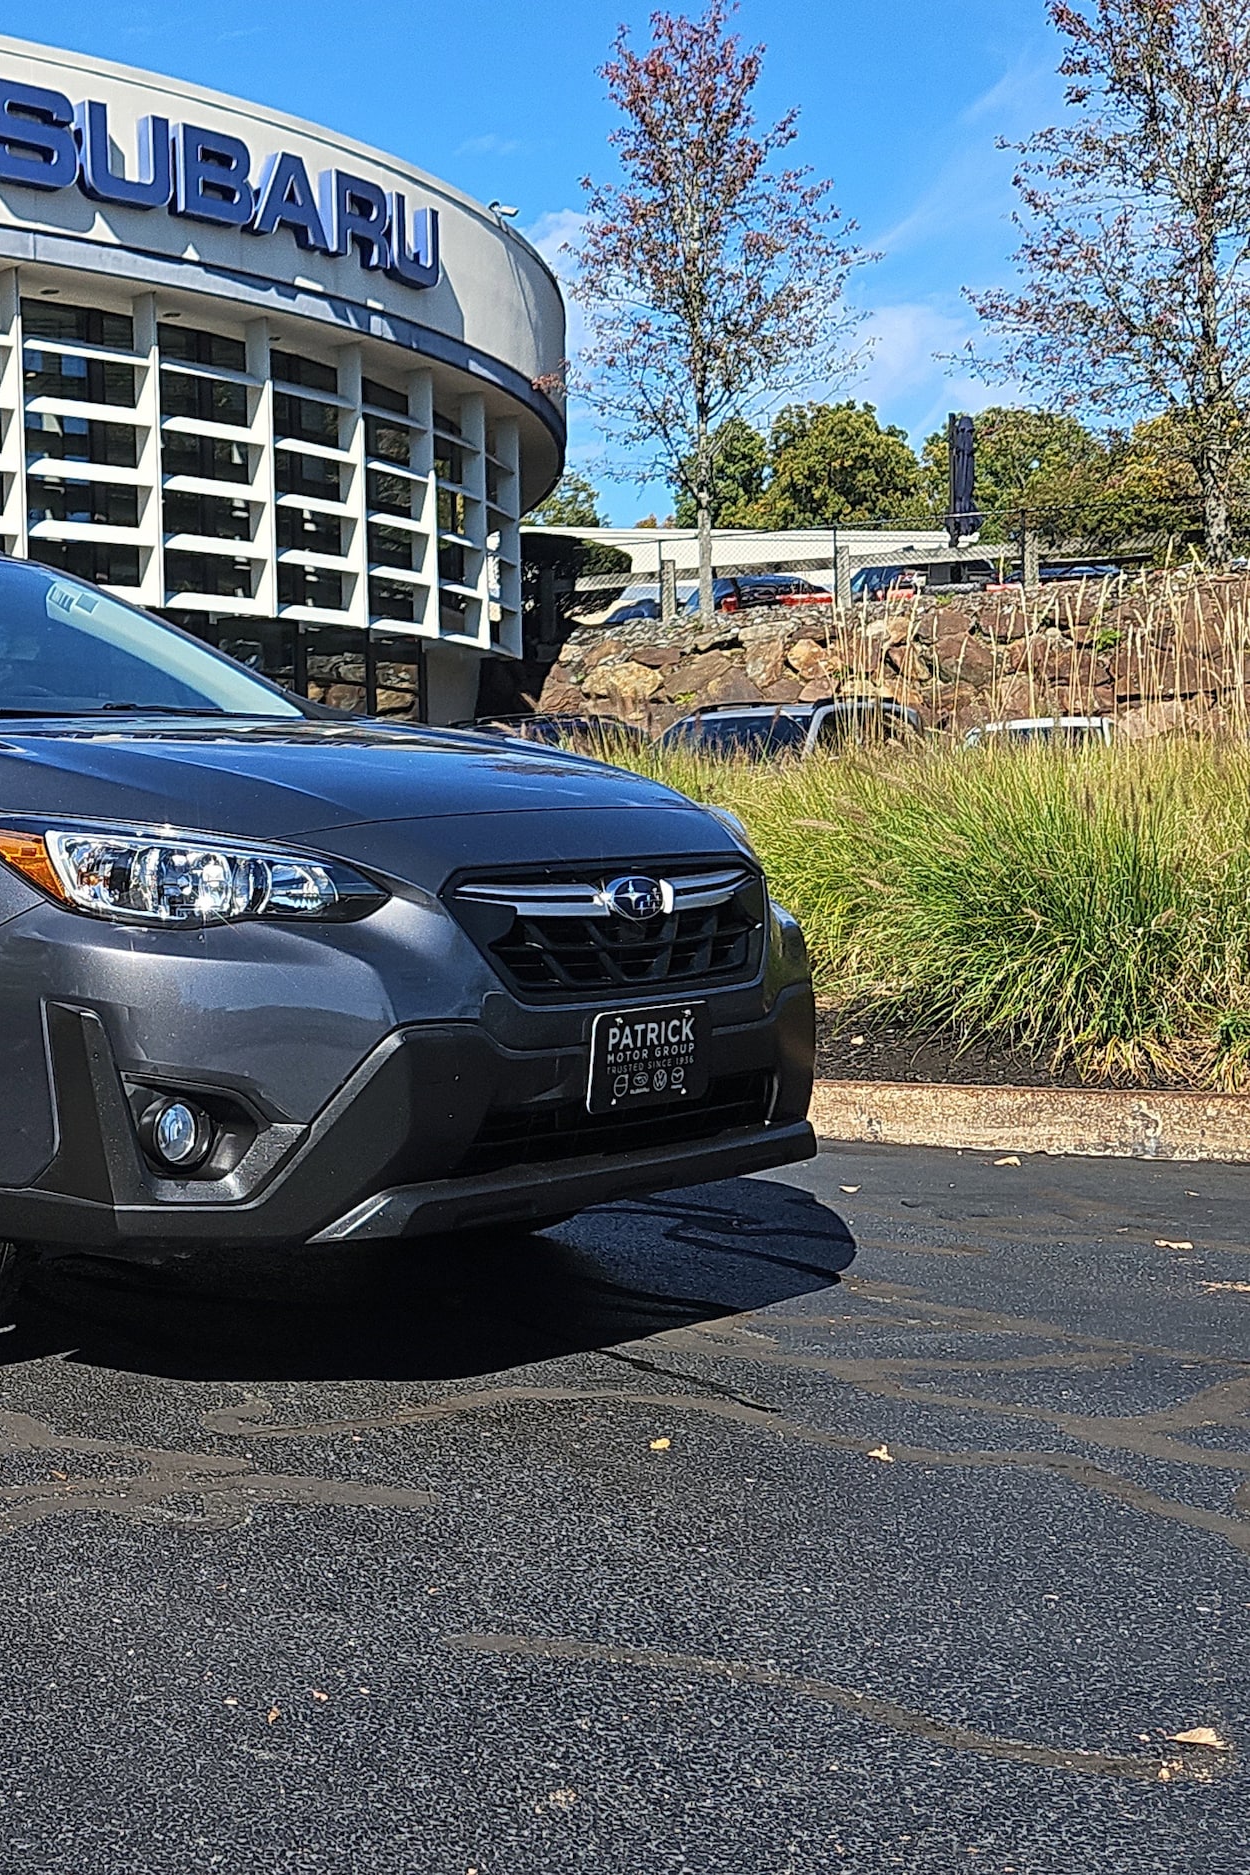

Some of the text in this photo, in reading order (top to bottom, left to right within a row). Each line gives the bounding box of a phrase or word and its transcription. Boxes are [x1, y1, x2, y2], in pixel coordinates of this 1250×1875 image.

[608, 1017, 695, 1051] PATRICK
[607, 1043, 695, 1064] MOTOR GROUP
[607, 1062, 645, 1075] TRUSTED
[647, 1057, 673, 1070] SINCE
